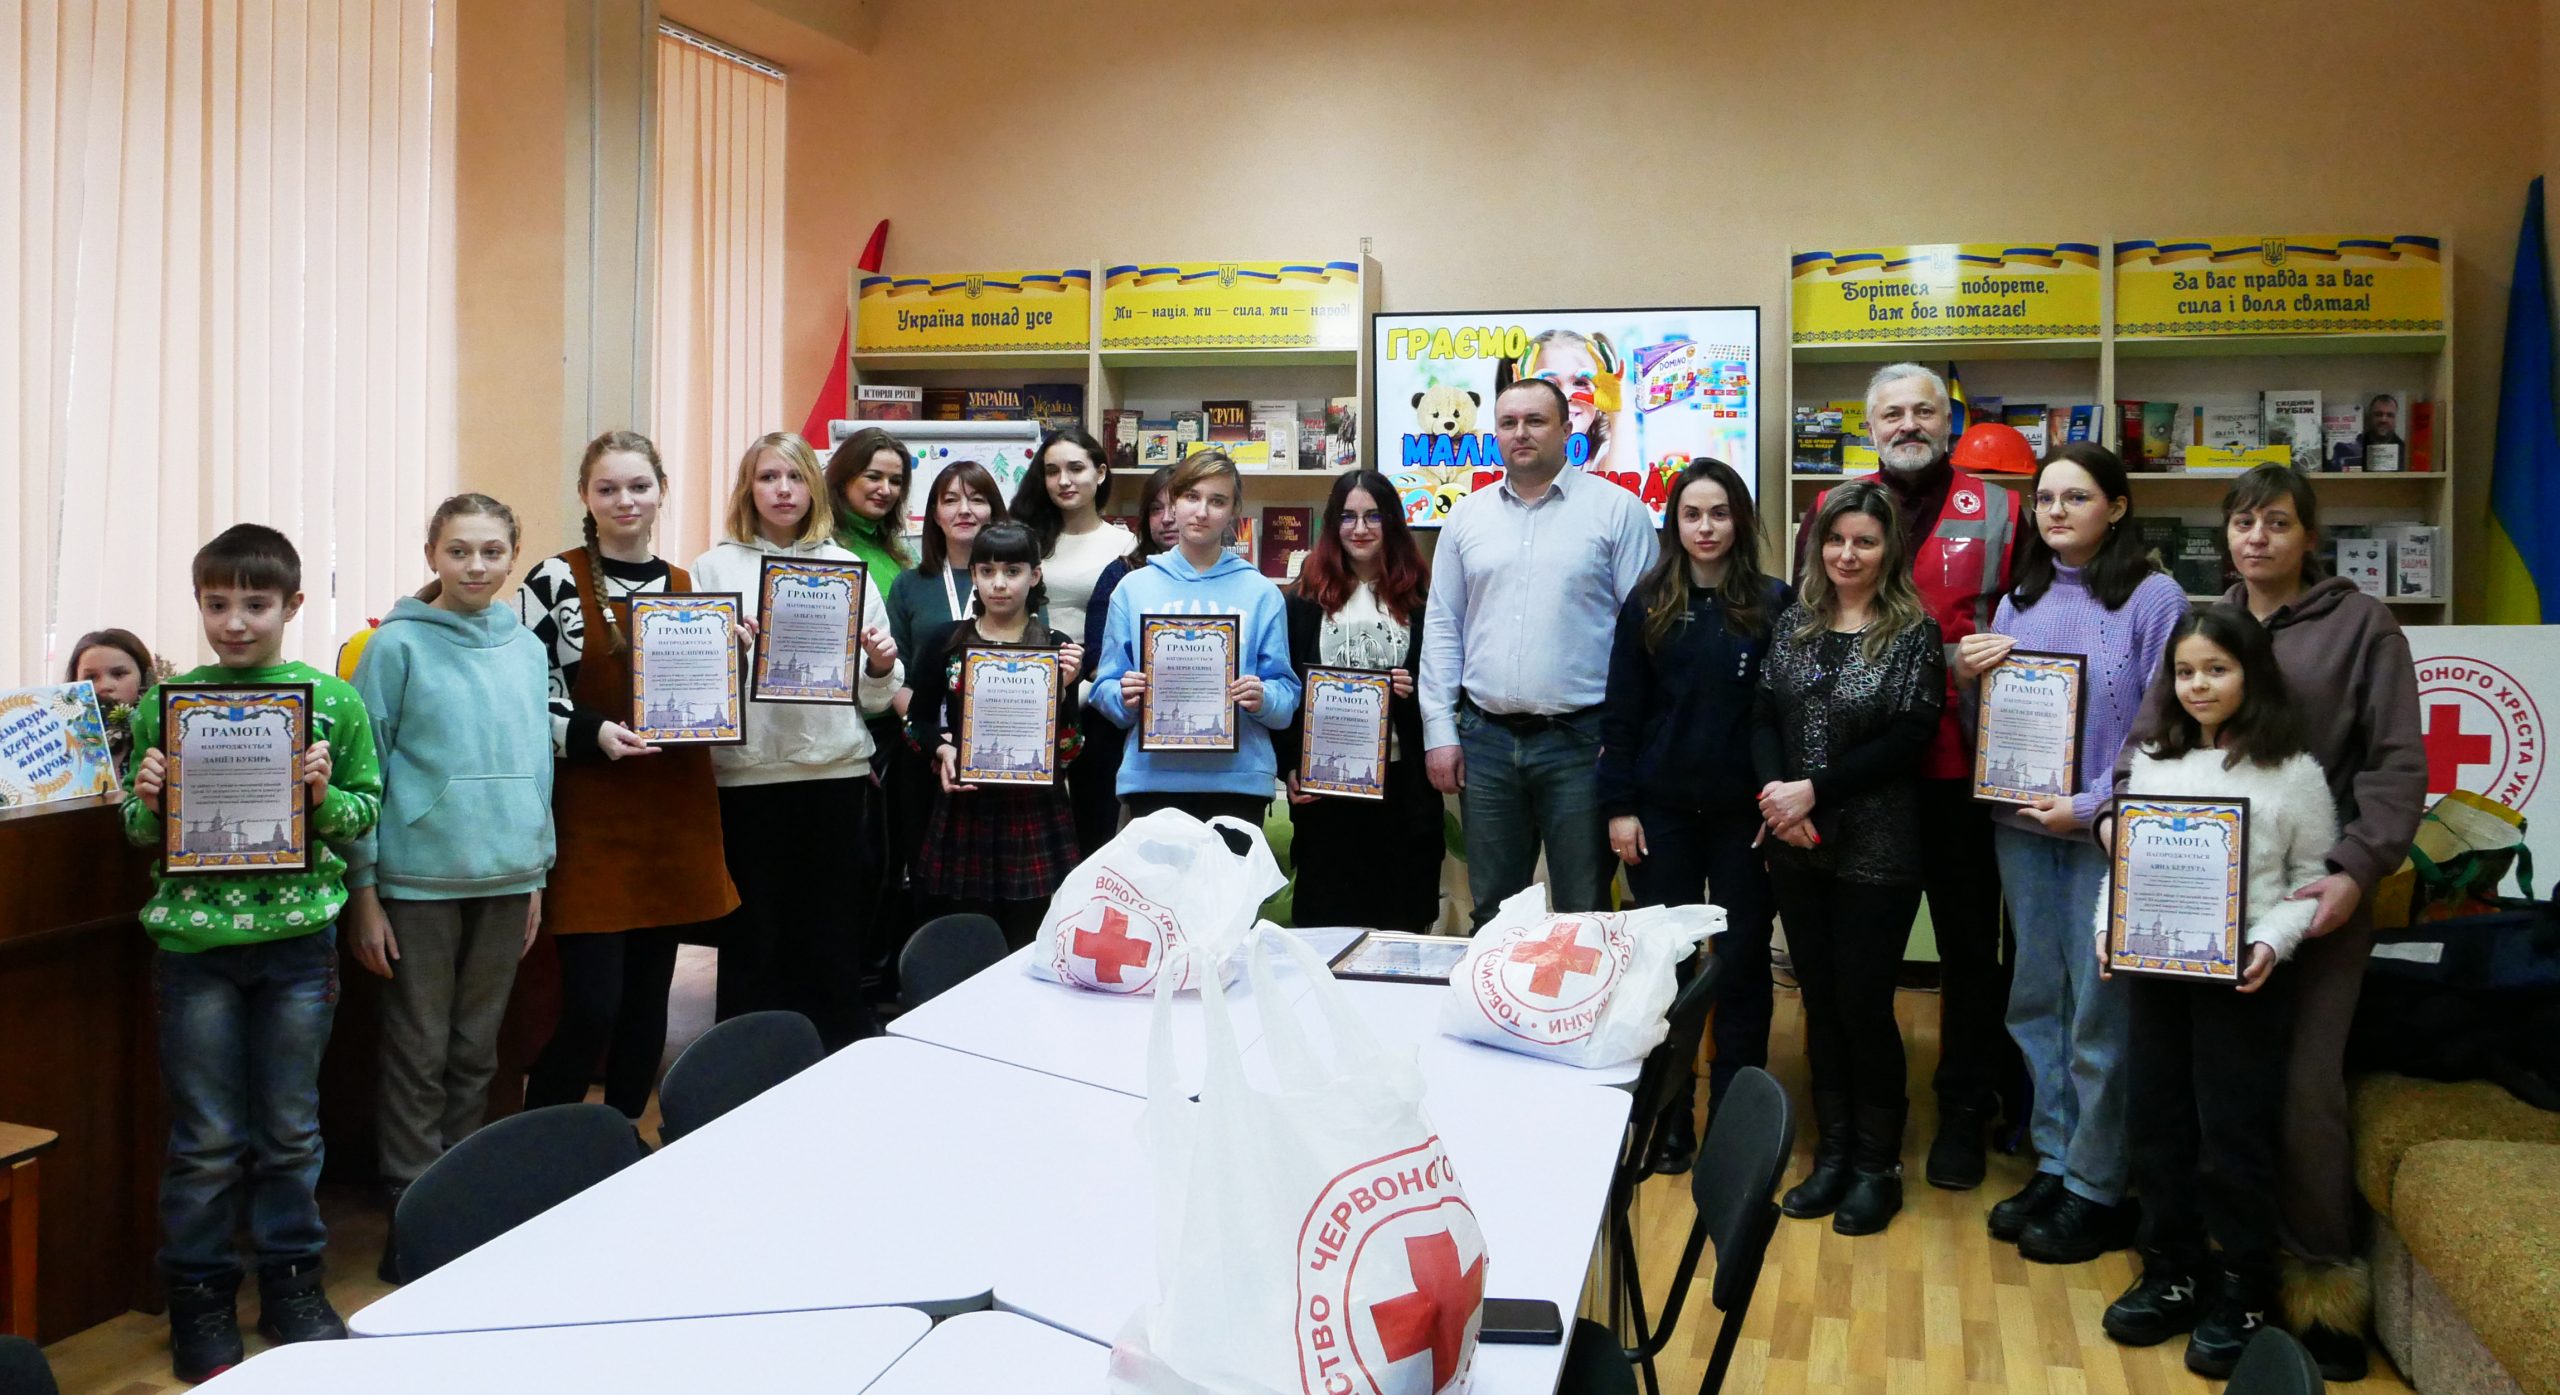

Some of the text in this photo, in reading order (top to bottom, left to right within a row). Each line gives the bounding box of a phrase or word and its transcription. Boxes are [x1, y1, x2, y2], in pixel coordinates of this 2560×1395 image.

[1841, 281, 1929, 301] Борітеся
[1961, 277, 2049, 297] поборете,
[2172, 269, 2374, 292] За вас правда за вас
[1112, 306, 1133, 322] Ми
[1151, 303, 1190, 320] нація,
[1193, 306, 1212, 317] ми
[1232, 304, 1266, 318] сила,
[1269, 305, 1289, 317] ми
[1868, 299, 2027, 321] вам бог помагає!
[2177, 293, 2371, 315] сила і воля святая!
[897, 306, 1053, 332] Україна понад усе
[1386, 326, 1528, 360] ГРАЄМО
[968, 389, 1020, 408] УКРАЇНА
[1209, 407, 1245, 425] КРУТИ
[1402, 432, 1590, 467] МАЛО
[788, 590, 836, 600] ГРАМОТА
[658, 627, 712, 635] ГРАМОТА
[1167, 644, 1213, 652] ГРАМОТА
[988, 676, 1035, 685] ГРАМОТА
[2005, 684, 2054, 696] ГРАМОТА
[1326, 695, 1369, 705] ГРАМОТА
[202, 726, 271, 737] ГРАМОТА
[2494, 687, 2534, 765] ХРЕСТА
[2147, 836, 2210, 847] ГРАМОТА
[1310, 1155, 1454, 1271] ЧЕРВОНОО
